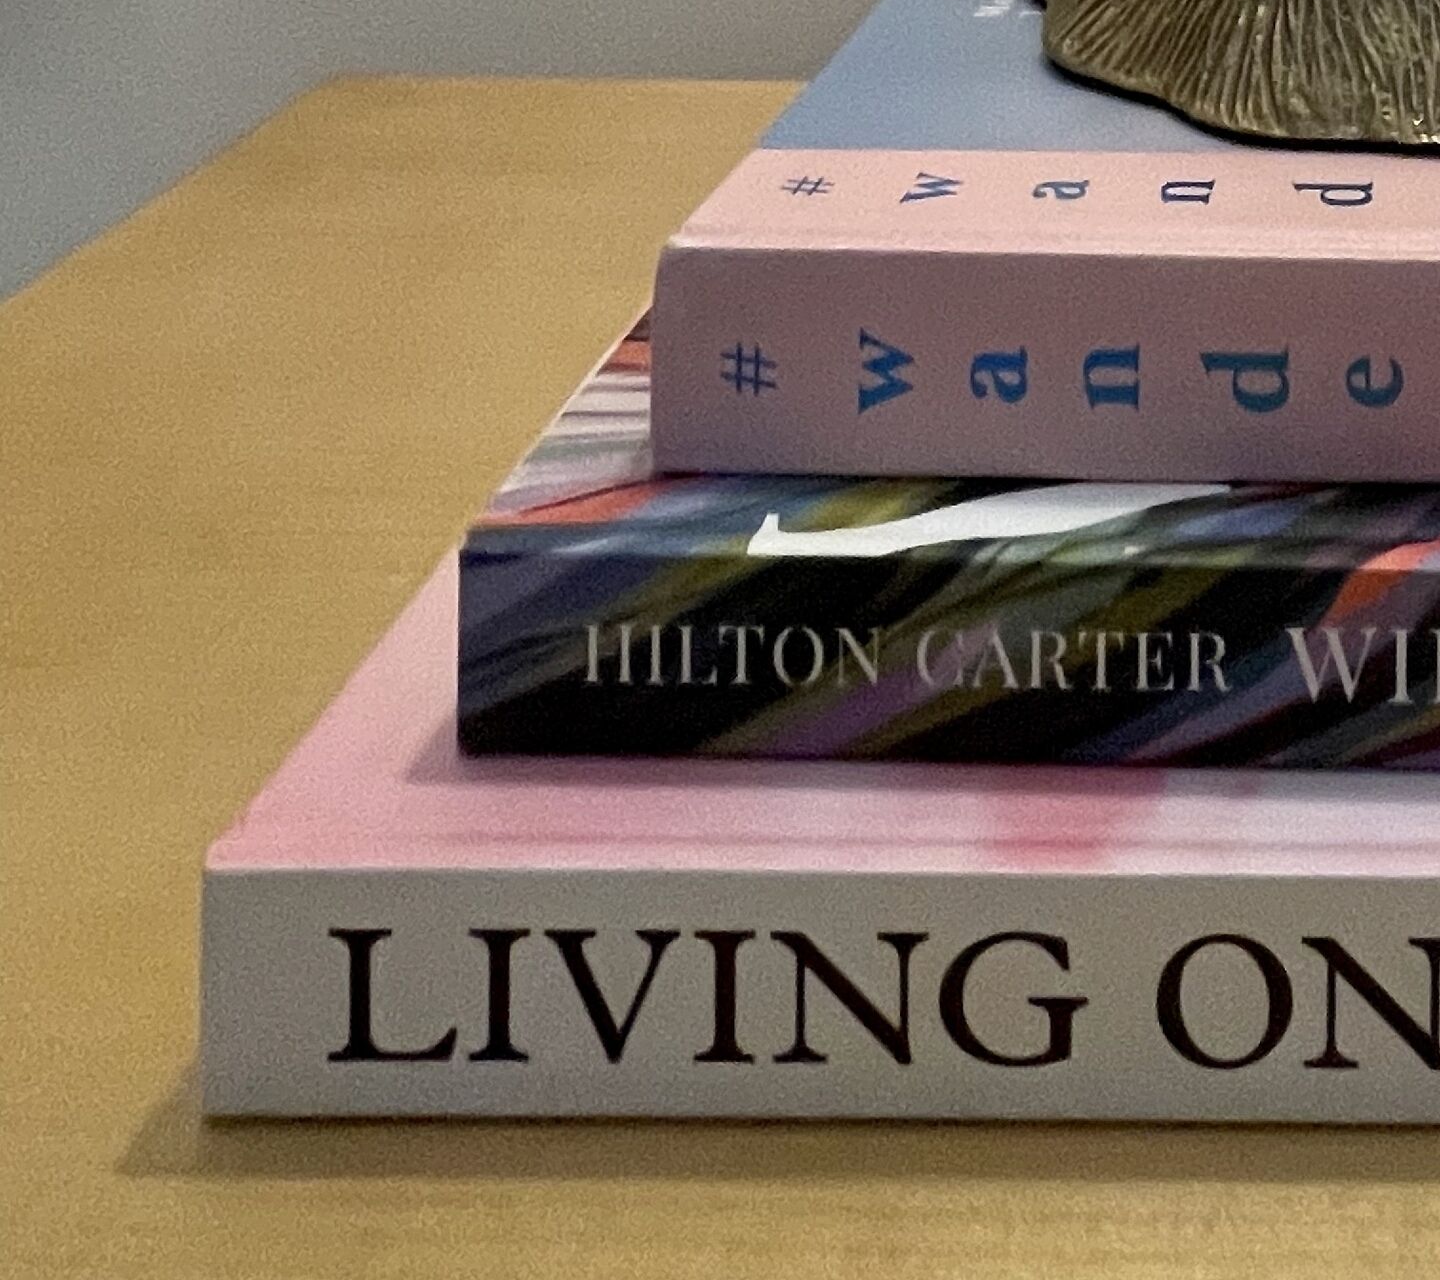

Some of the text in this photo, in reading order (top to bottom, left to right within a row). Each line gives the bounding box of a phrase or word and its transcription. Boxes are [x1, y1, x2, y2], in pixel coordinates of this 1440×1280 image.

[583, 623, 881, 688] HILTON
[916, 626, 1232, 693] CARTER
[327, 927, 1090, 1067] LIVING
